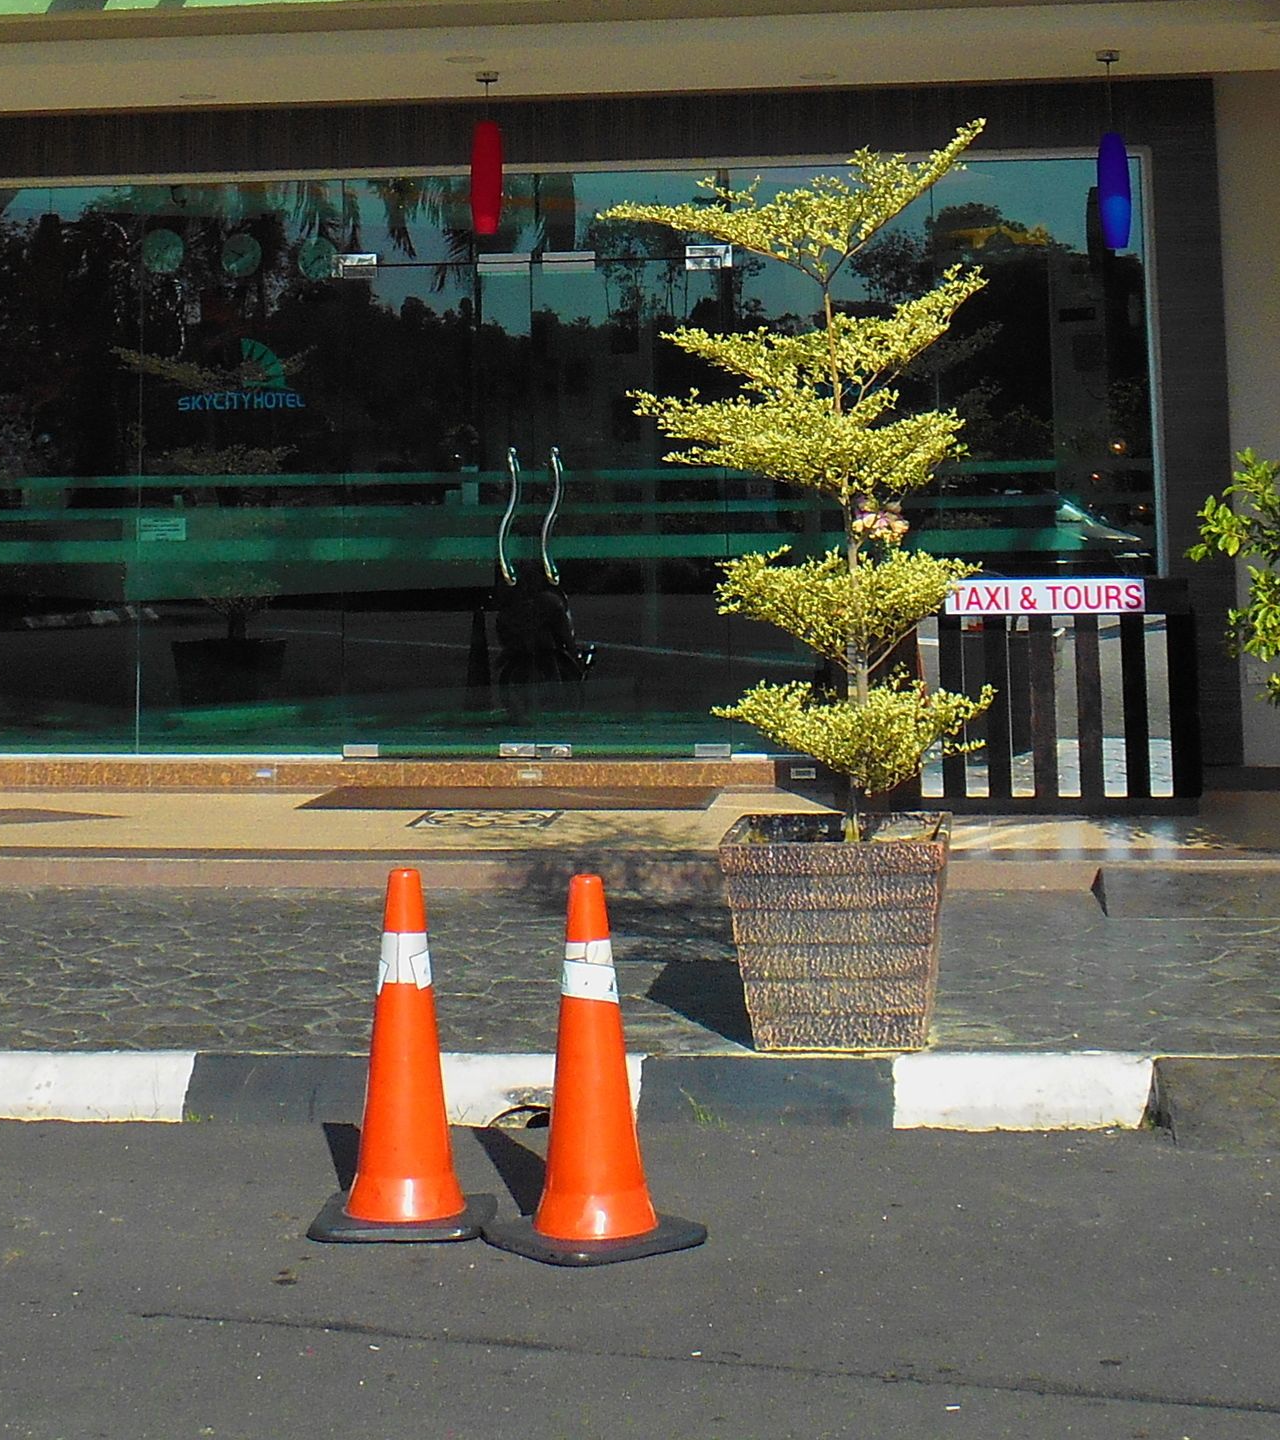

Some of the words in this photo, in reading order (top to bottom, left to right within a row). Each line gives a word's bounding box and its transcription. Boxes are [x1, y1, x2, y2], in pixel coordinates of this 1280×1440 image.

[953, 586, 1011, 611] TAXI
[1020, 586, 1038, 610] &
[1046, 584, 1143, 610] TOURS
